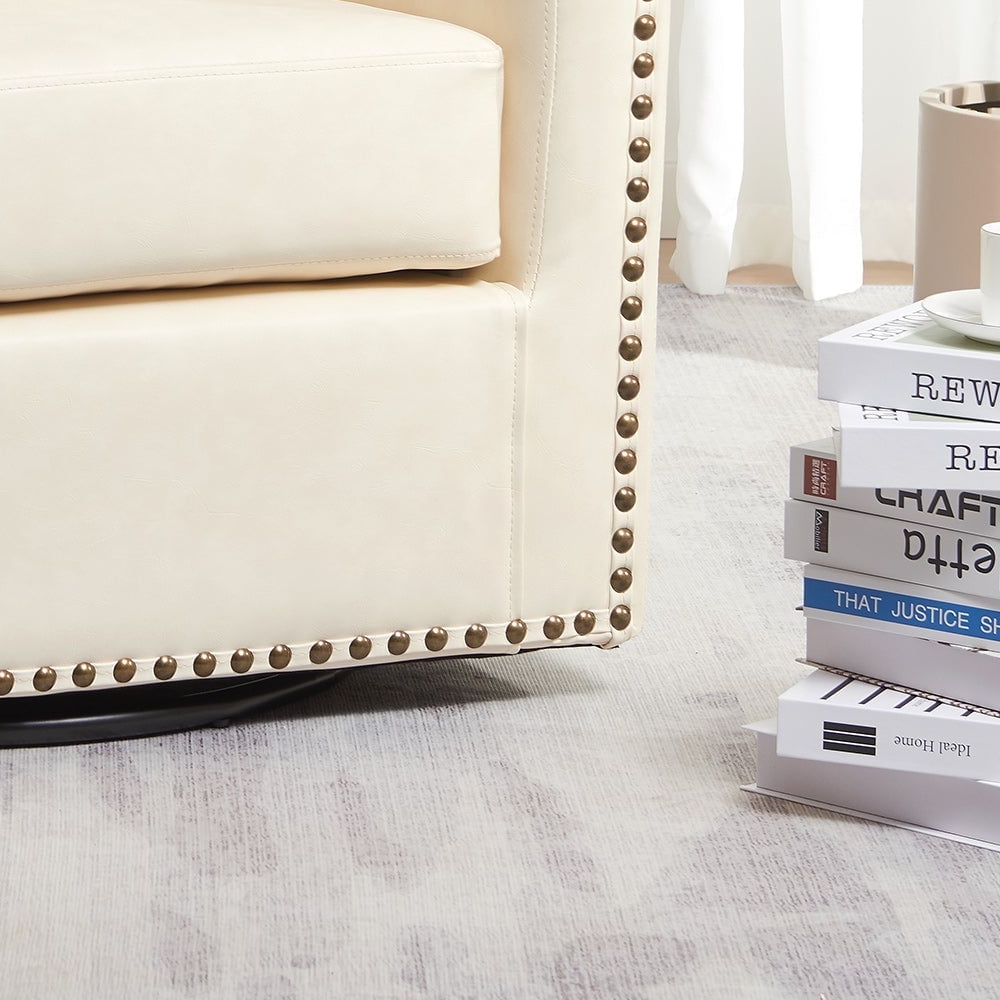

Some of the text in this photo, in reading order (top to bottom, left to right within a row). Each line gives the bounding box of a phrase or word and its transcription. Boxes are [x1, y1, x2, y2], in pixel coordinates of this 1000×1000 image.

[911, 372, 1000, 408] REW
[945, 444, 1000, 471] RE
[820, 461, 828, 495] CRAFT
[903, 528, 996, 579] etta
[834, 589, 882, 613] THAT
[891, 601, 970, 630] JUSTICE
[894, 735, 971, 757] Ideal Home
